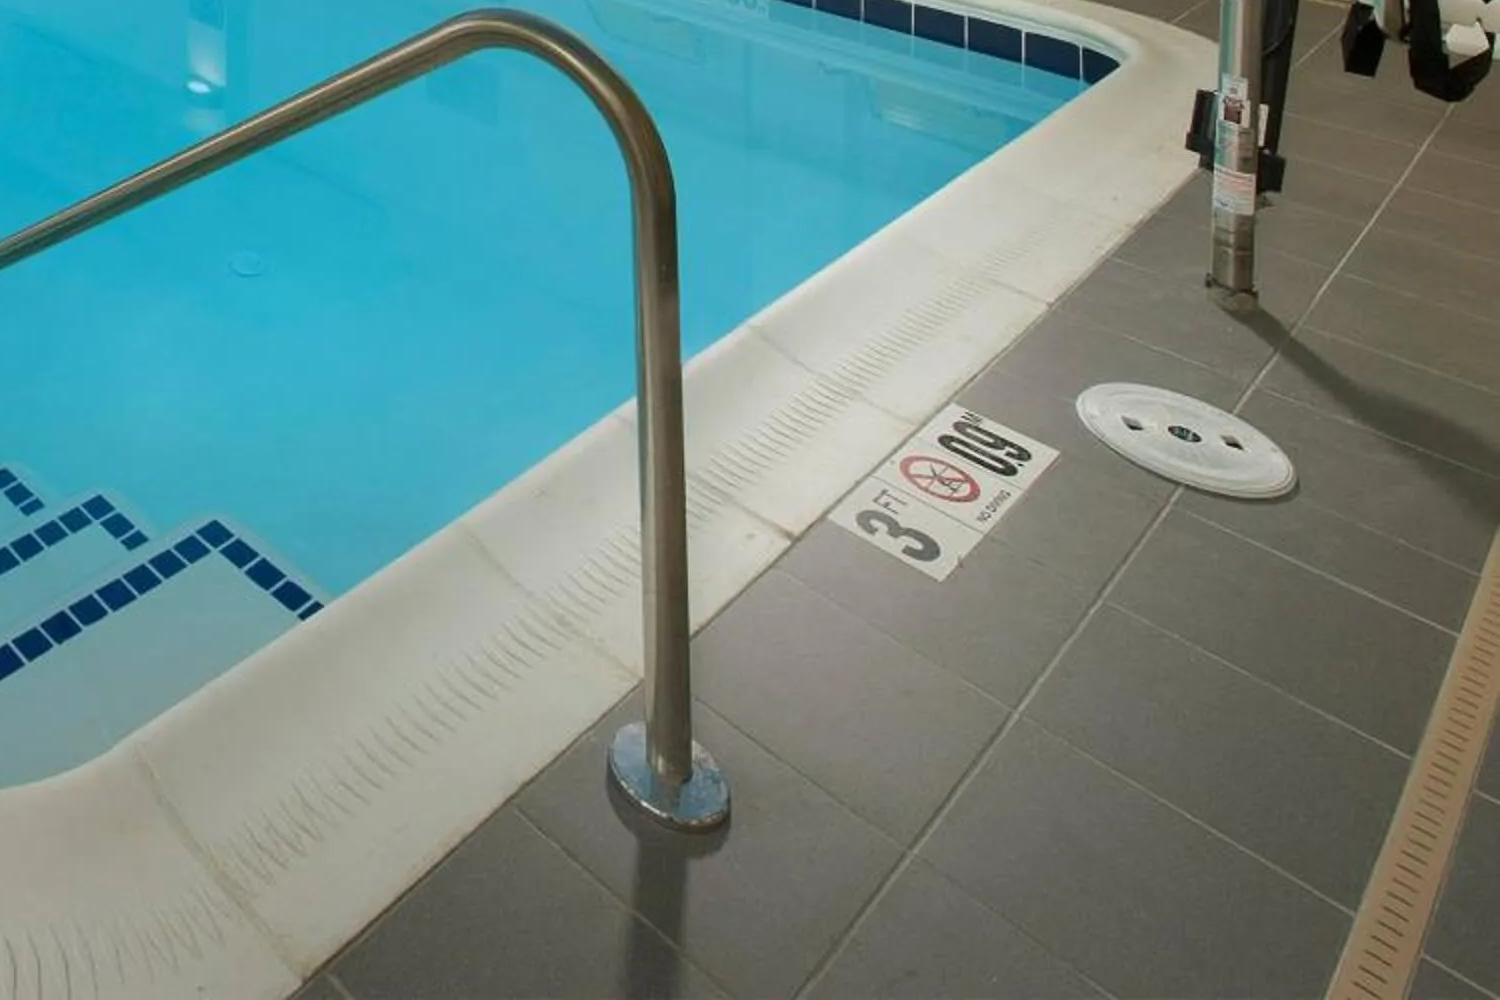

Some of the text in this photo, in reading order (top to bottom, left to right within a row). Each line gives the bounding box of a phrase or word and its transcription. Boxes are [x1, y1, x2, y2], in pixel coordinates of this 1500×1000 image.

[937, 420, 1033, 477] 0.9
[855, 488, 941, 562] 3 FT
